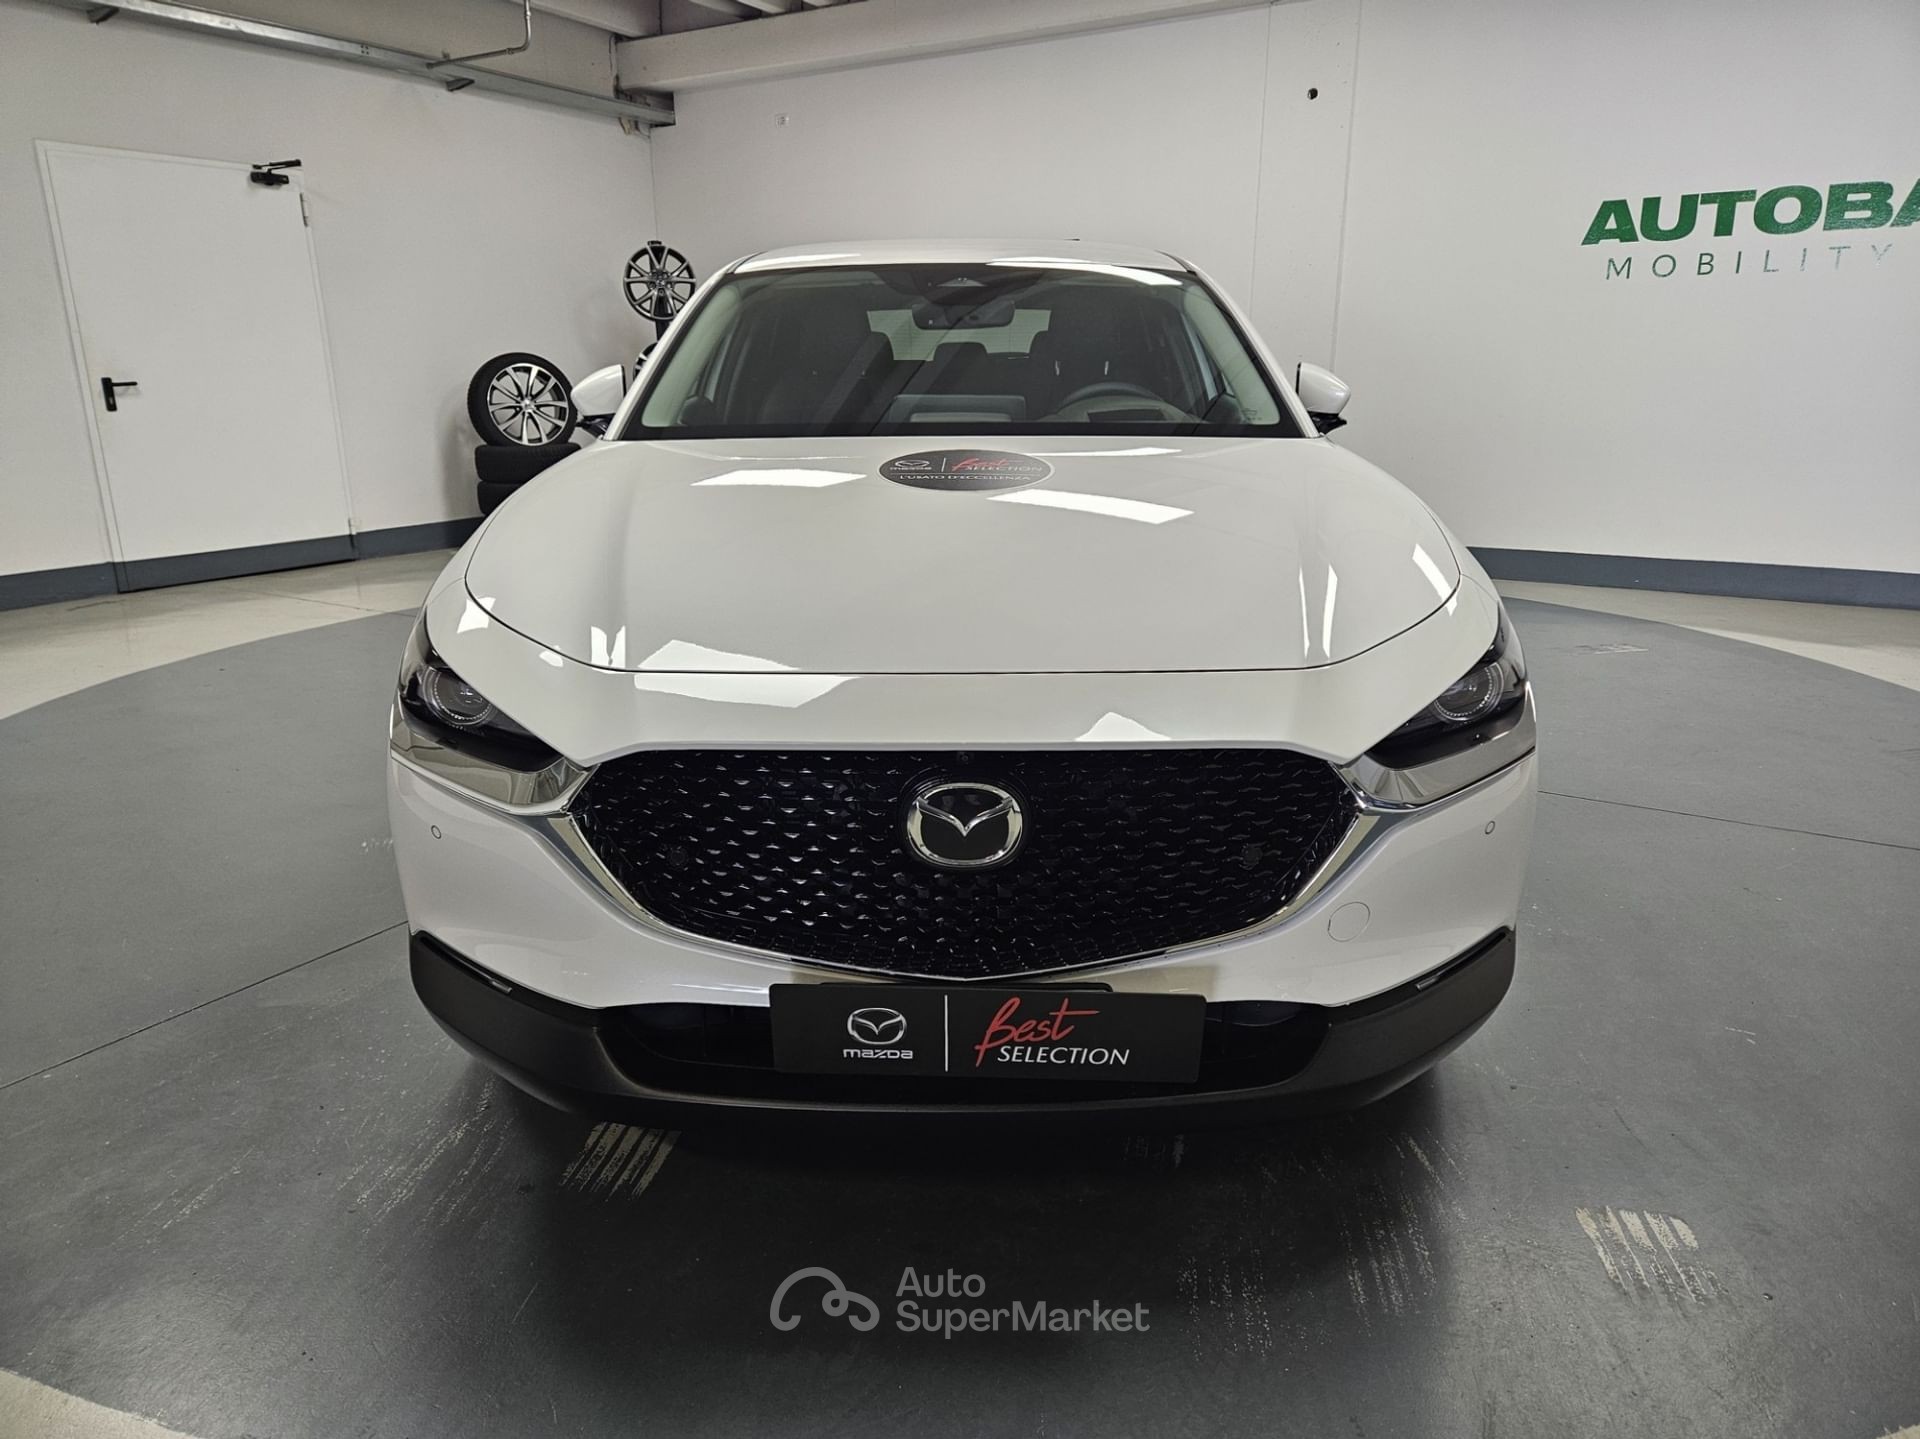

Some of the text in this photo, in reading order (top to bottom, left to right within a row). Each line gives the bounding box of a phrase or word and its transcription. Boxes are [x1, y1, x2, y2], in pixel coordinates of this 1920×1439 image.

[1606, 244, 1892, 280] MOBILITY
[974, 996, 1099, 1067] Best
[997, 1046, 1130, 1066] SELECTION
